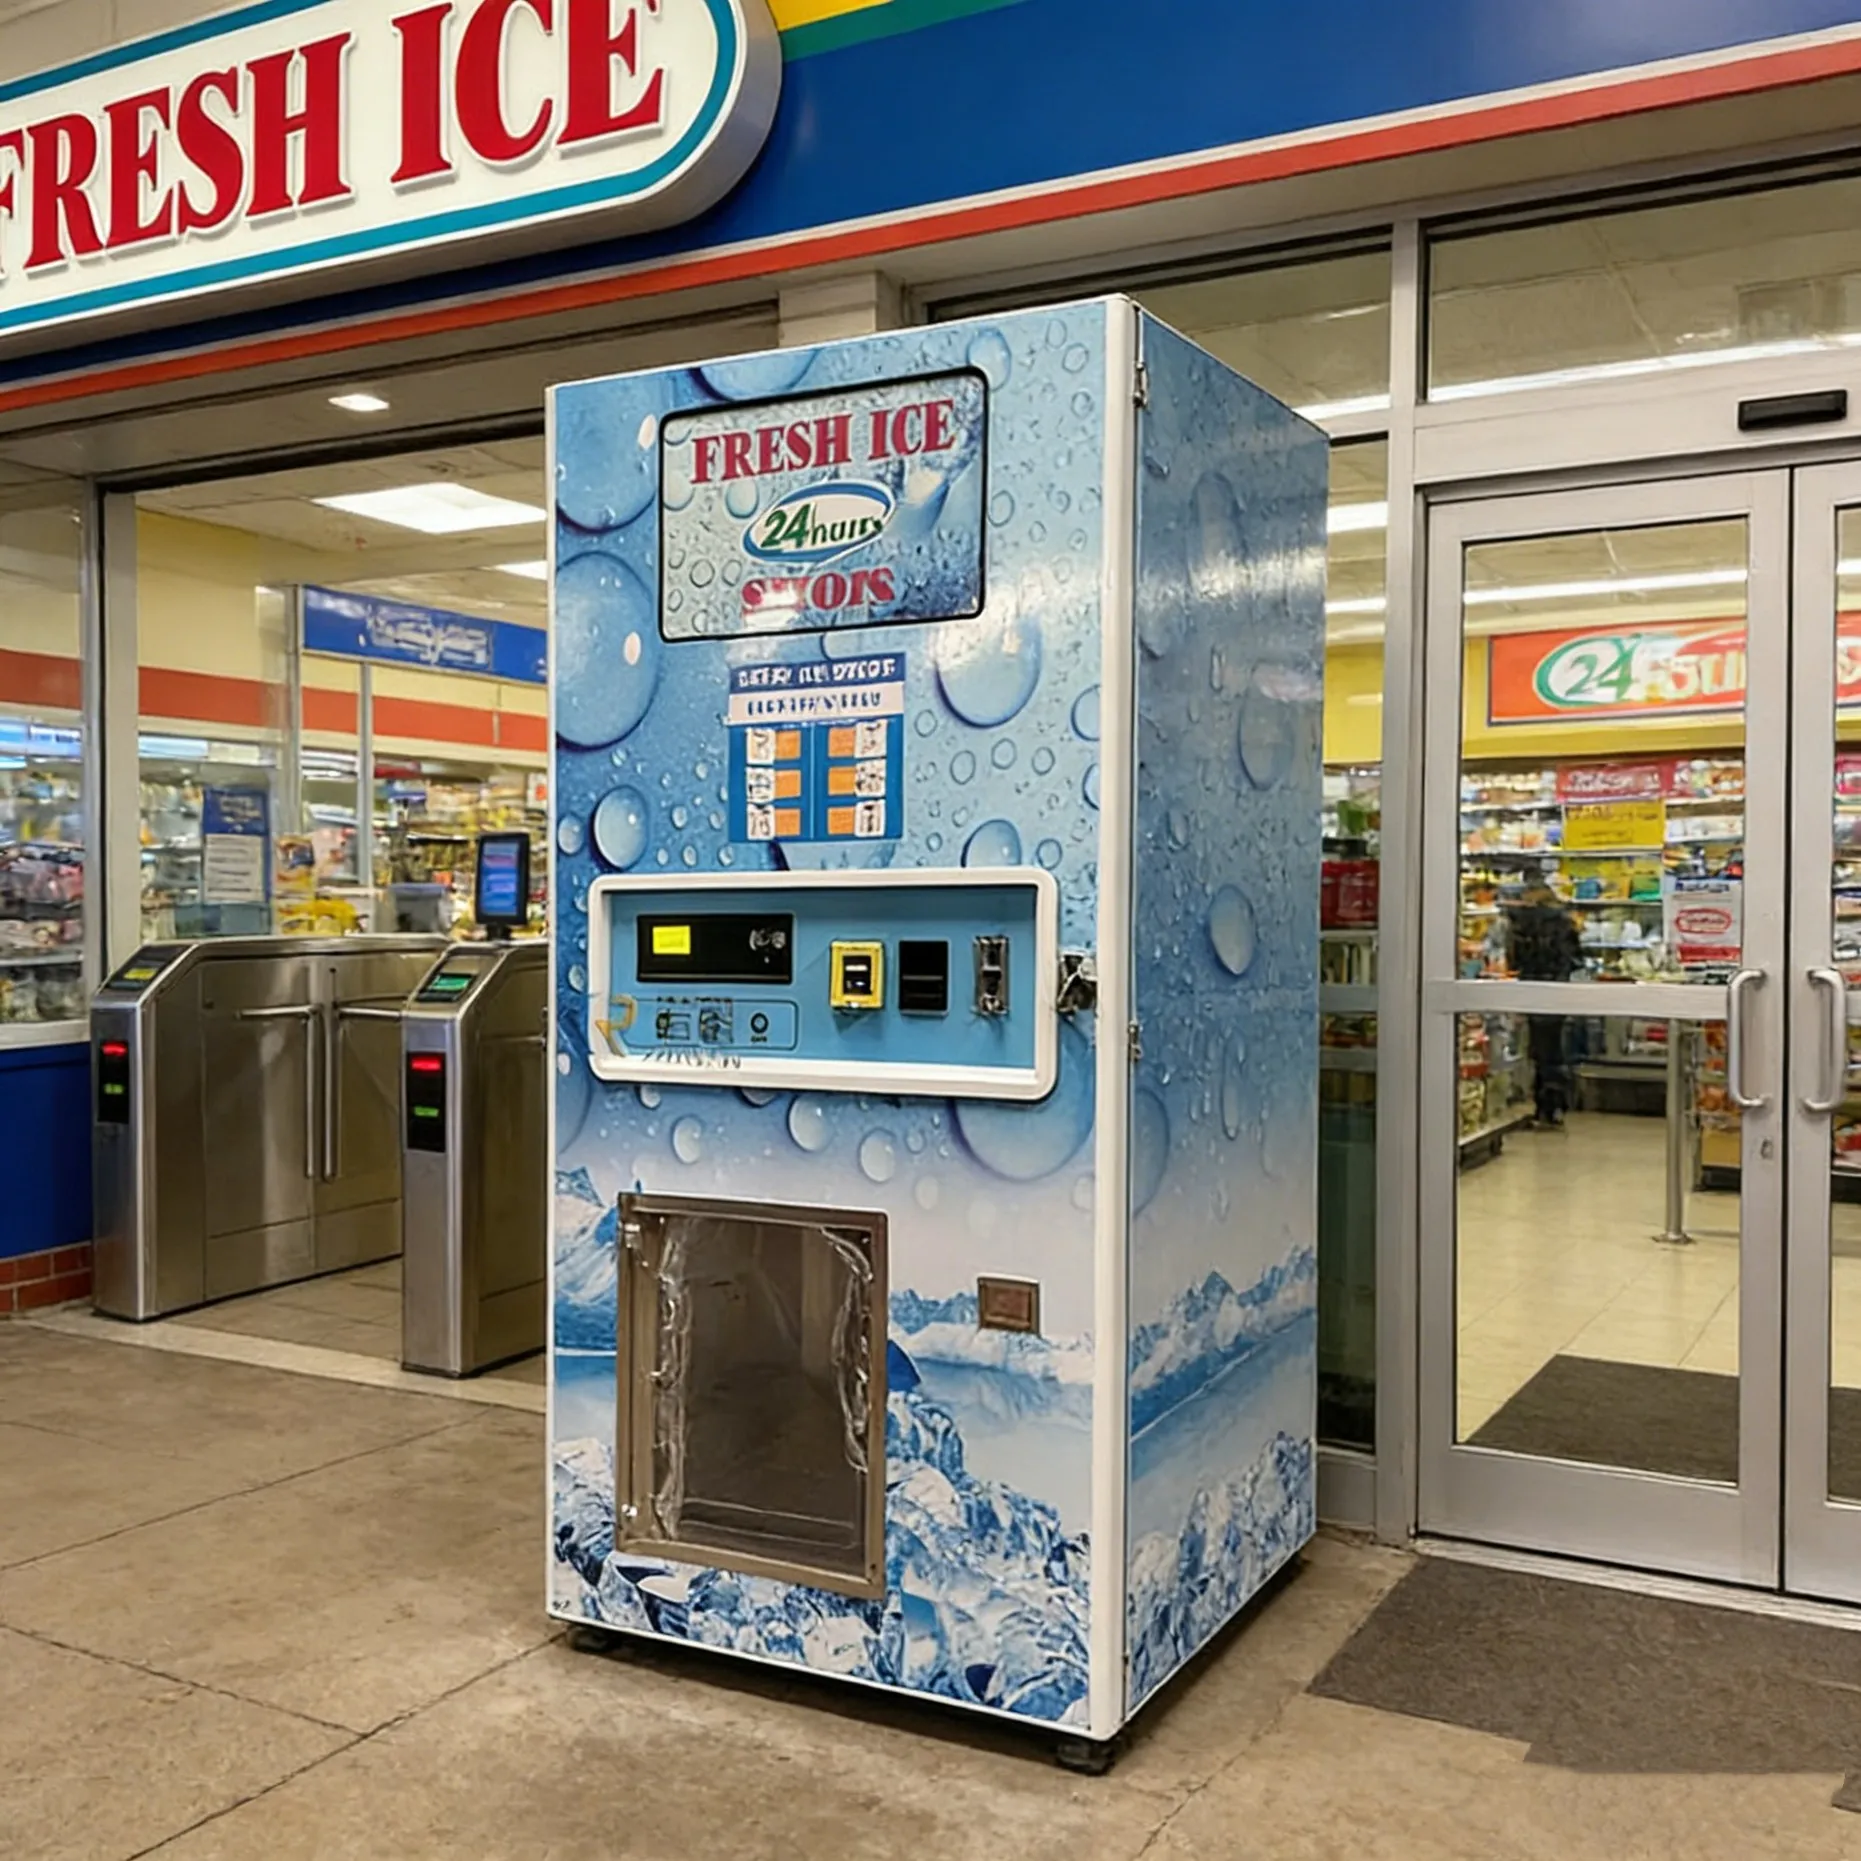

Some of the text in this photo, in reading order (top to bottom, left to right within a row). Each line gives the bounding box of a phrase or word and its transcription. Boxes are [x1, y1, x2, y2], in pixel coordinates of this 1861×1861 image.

[390, 0, 664, 184] ICE
[690, 400, 956, 485] FRESH ICE
